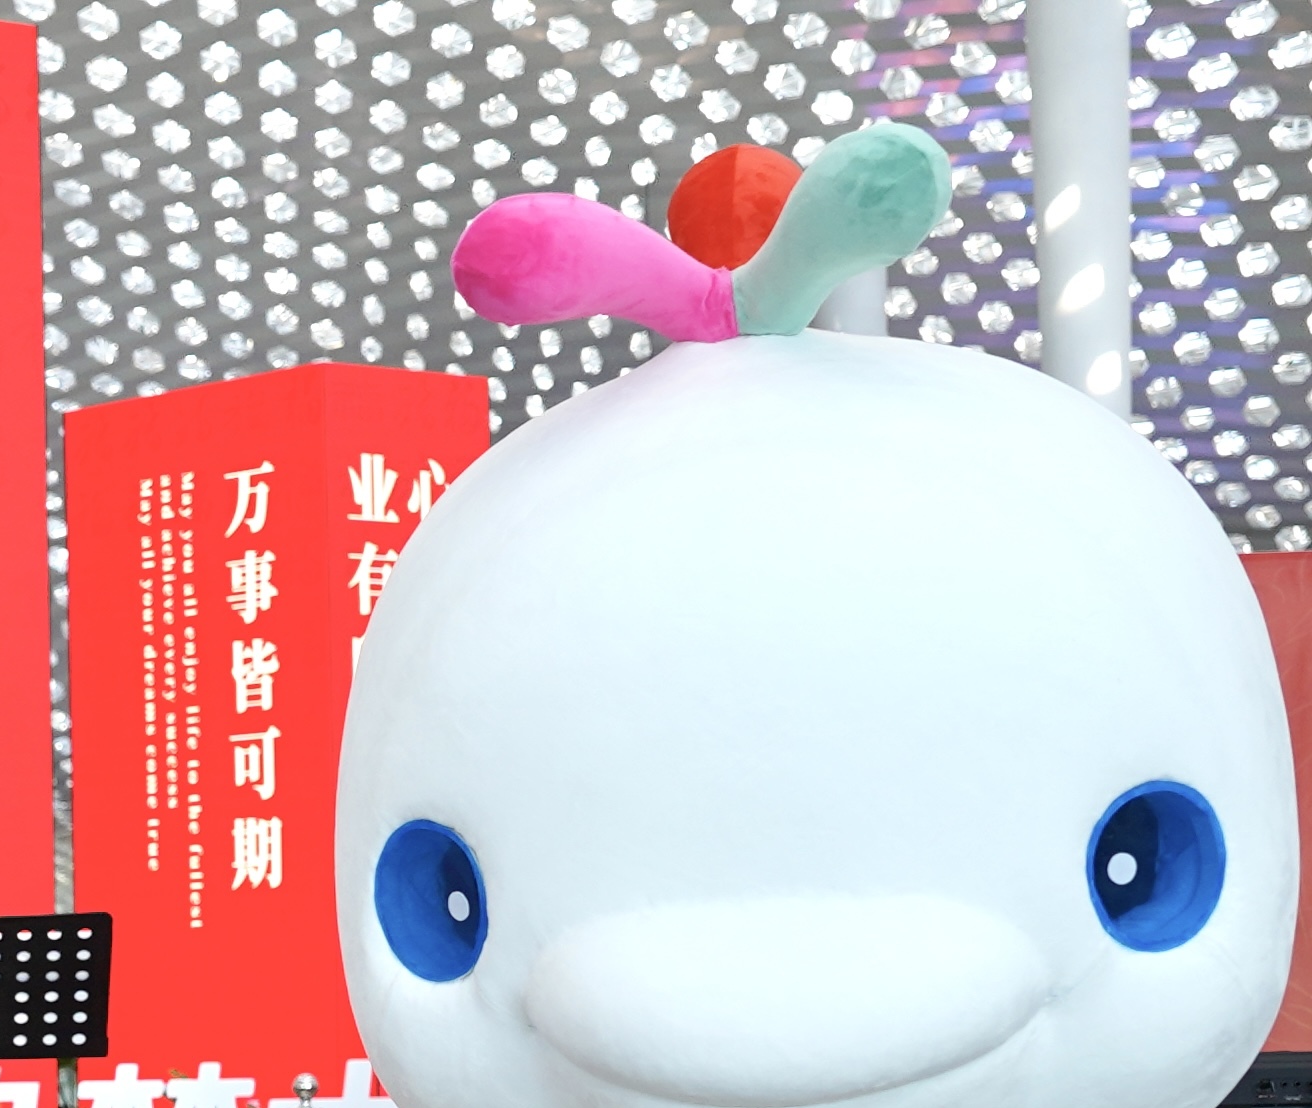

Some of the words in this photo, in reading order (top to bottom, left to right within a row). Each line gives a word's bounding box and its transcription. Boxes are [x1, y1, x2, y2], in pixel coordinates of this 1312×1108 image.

[137, 478, 153, 526] May
[160, 474, 175, 520] and
[178, 471, 195, 520] May
[140, 535, 156, 569] all
[179, 529, 194, 573] you
[347, 452, 400, 676] 业有
[161, 529, 177, 625] achieve
[182, 583, 198, 616] all
[139, 578, 155, 636] your
[162, 633, 176, 702] every
[182, 626, 200, 695] enjoy
[224, 461, 283, 891] 万事皆可期
[143, 644, 158, 736] dreams
[186, 705, 201, 750] life
[145, 744, 158, 809] come
[187, 760, 201, 784] to
[188, 794, 203, 835] the
[147, 818, 160, 872] true
